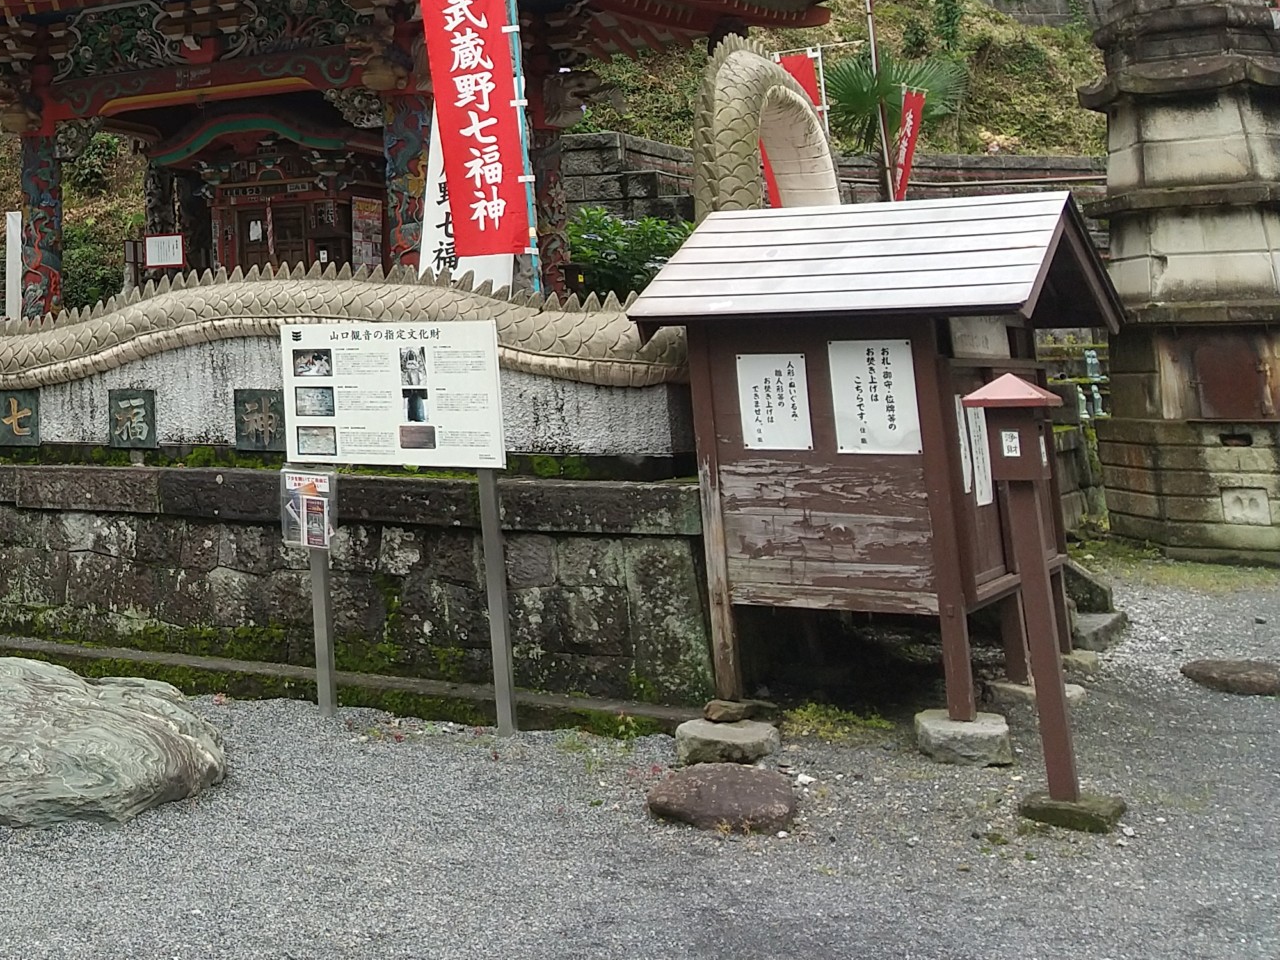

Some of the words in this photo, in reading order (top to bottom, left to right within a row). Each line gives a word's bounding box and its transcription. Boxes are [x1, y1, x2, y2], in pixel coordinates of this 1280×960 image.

[329, 327, 441, 341] 山口観音の指定文化財
[866, 347, 879, 402] お焚き上げは
[880, 347, 897, 431] お札・御守・位牌等の
[1, 397, 32, 436] 七
[114, 397, 150, 441] 福
[241, 396, 277, 446] 神
[752, 385, 763, 426] できません。
[763, 377, 774, 423] お焚き上げは
[854, 375, 867, 424] こちらです。
[1005, 433, 1018, 454] 浄財
